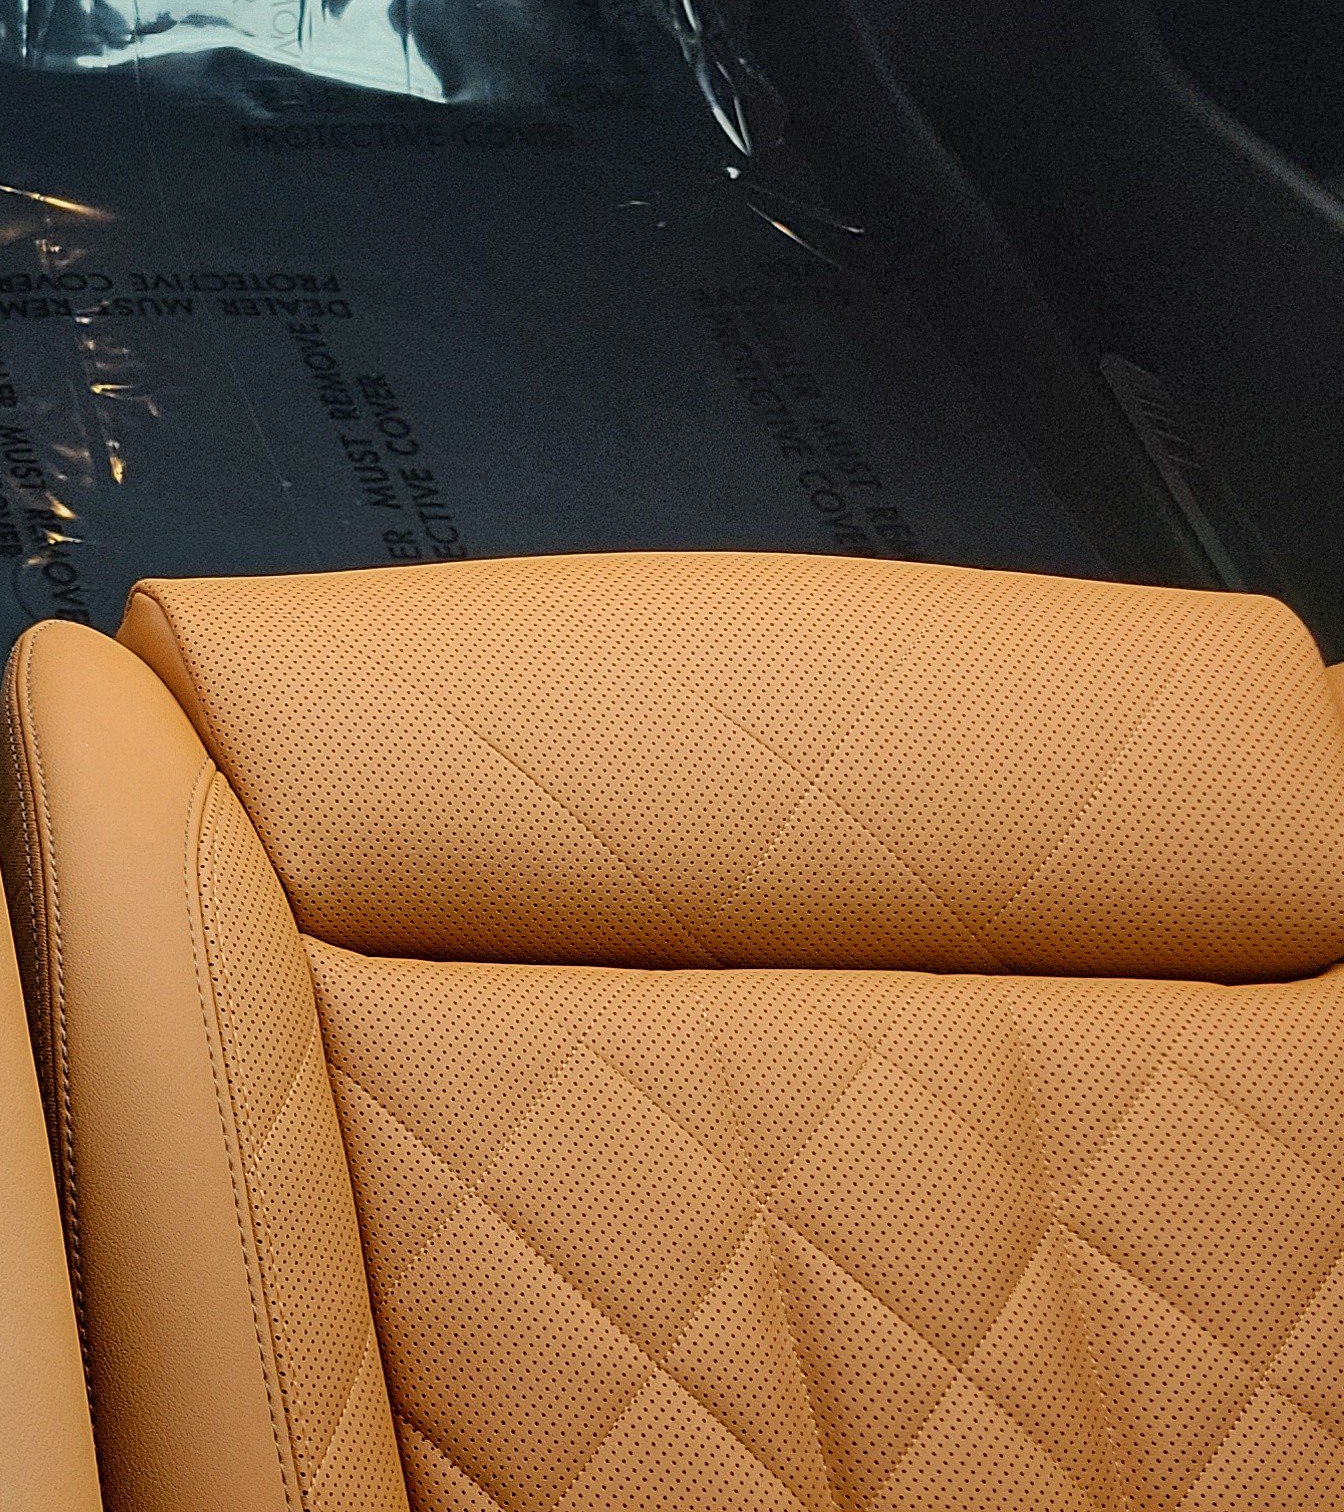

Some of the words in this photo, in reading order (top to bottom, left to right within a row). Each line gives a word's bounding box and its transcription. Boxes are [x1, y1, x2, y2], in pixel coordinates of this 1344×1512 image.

[132, 271, 342, 294] PROTECTIVE
[223, 298, 353, 320] DEALER
[398, 467, 470, 562] ECTIVE
